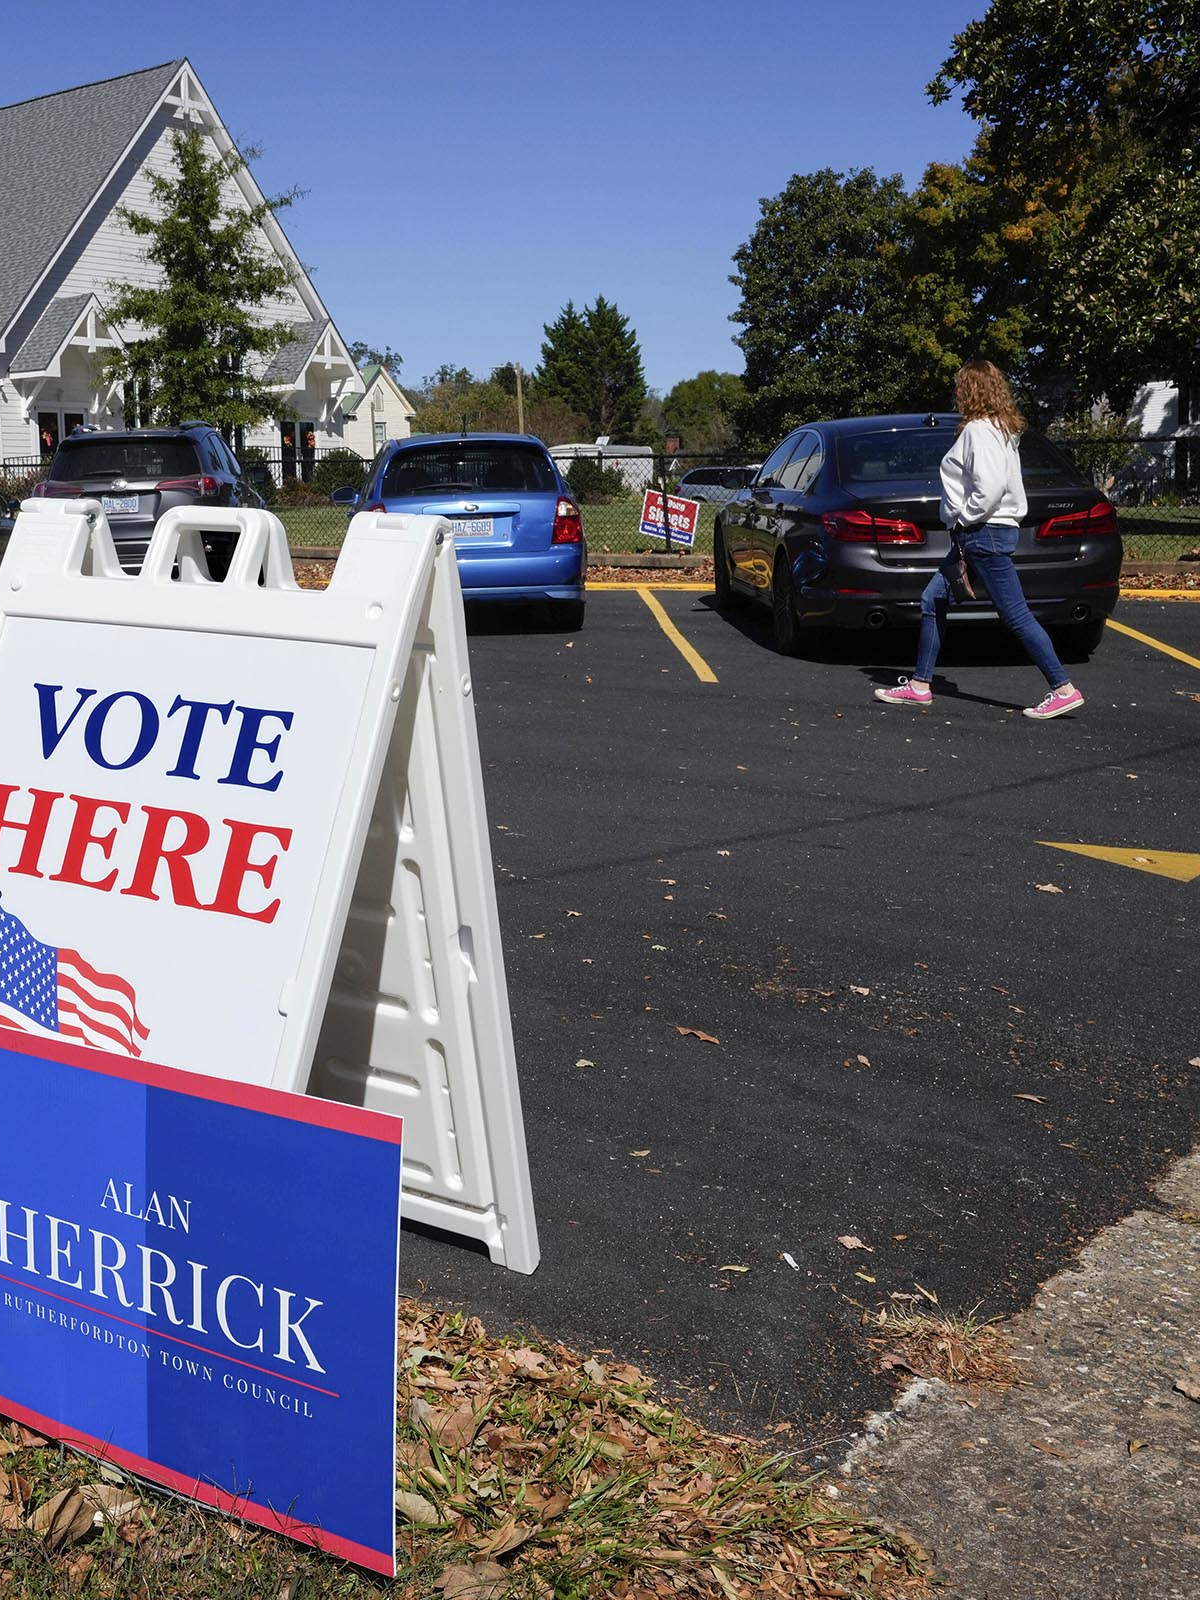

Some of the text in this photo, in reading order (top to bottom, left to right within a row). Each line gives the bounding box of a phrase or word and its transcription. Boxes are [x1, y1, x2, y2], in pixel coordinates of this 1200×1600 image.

[451, 521, 491, 533] HAZ-6689
[33, 682, 294, 792] VOTE
[100, 1178, 191, 1234] ALAN
[3, 1292, 313, 1418] RUTHERFORDTON TOWN COUNCIL
